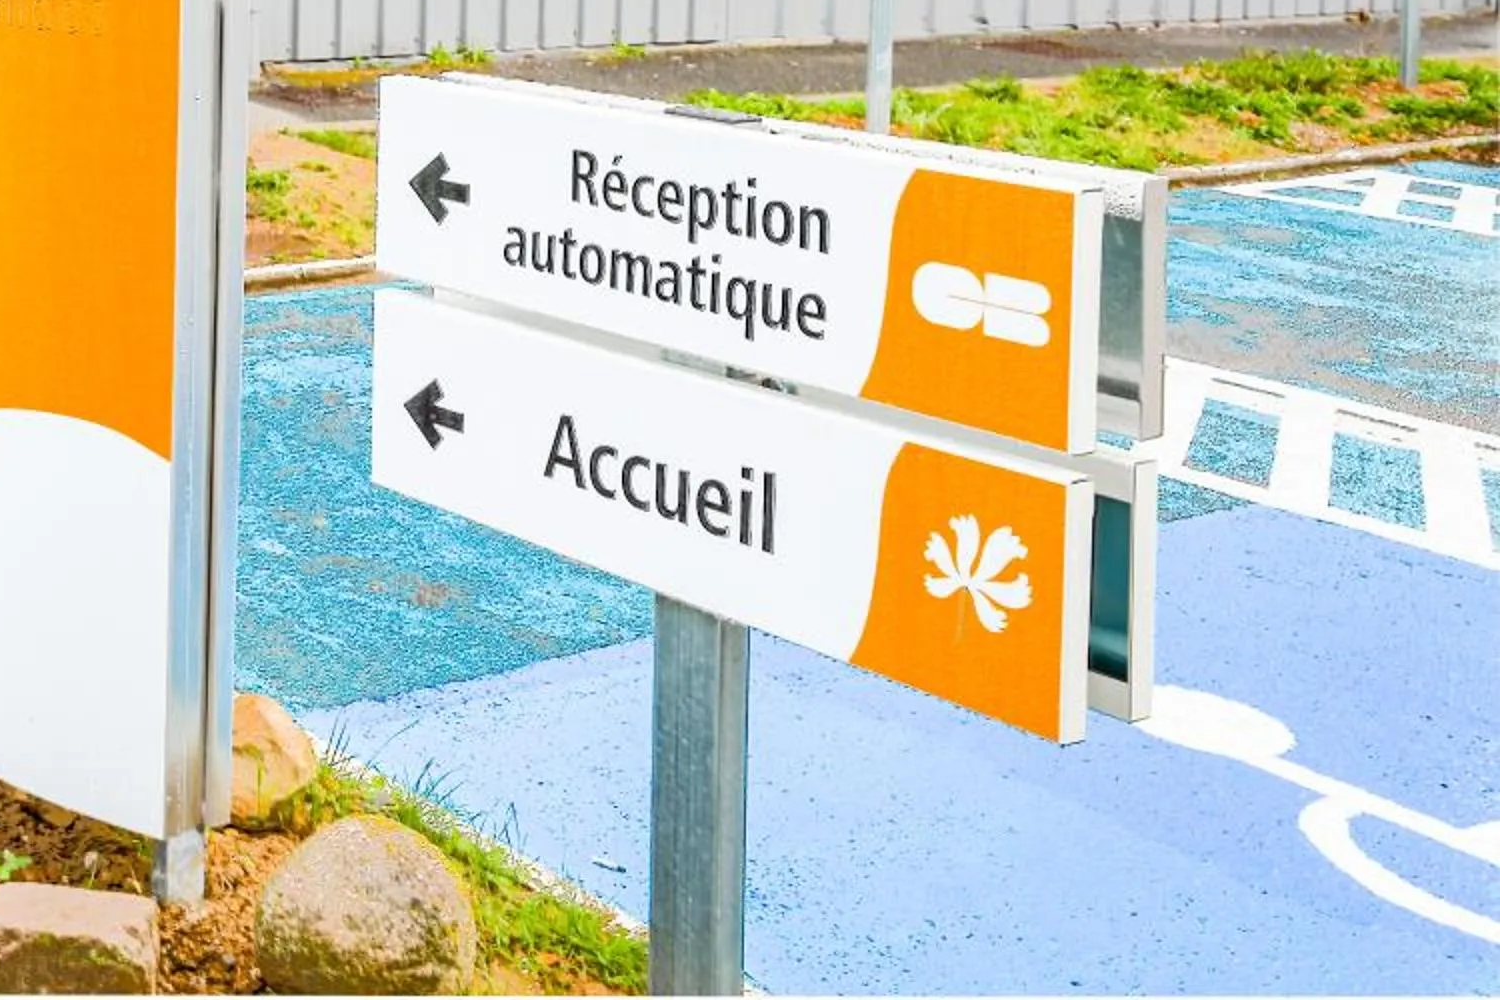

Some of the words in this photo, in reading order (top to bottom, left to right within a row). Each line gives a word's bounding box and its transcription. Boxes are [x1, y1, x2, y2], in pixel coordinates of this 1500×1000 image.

[571, 149, 830, 256] Réception
[503, 224, 828, 343] automatique
[543, 413, 776, 554] Accueil
